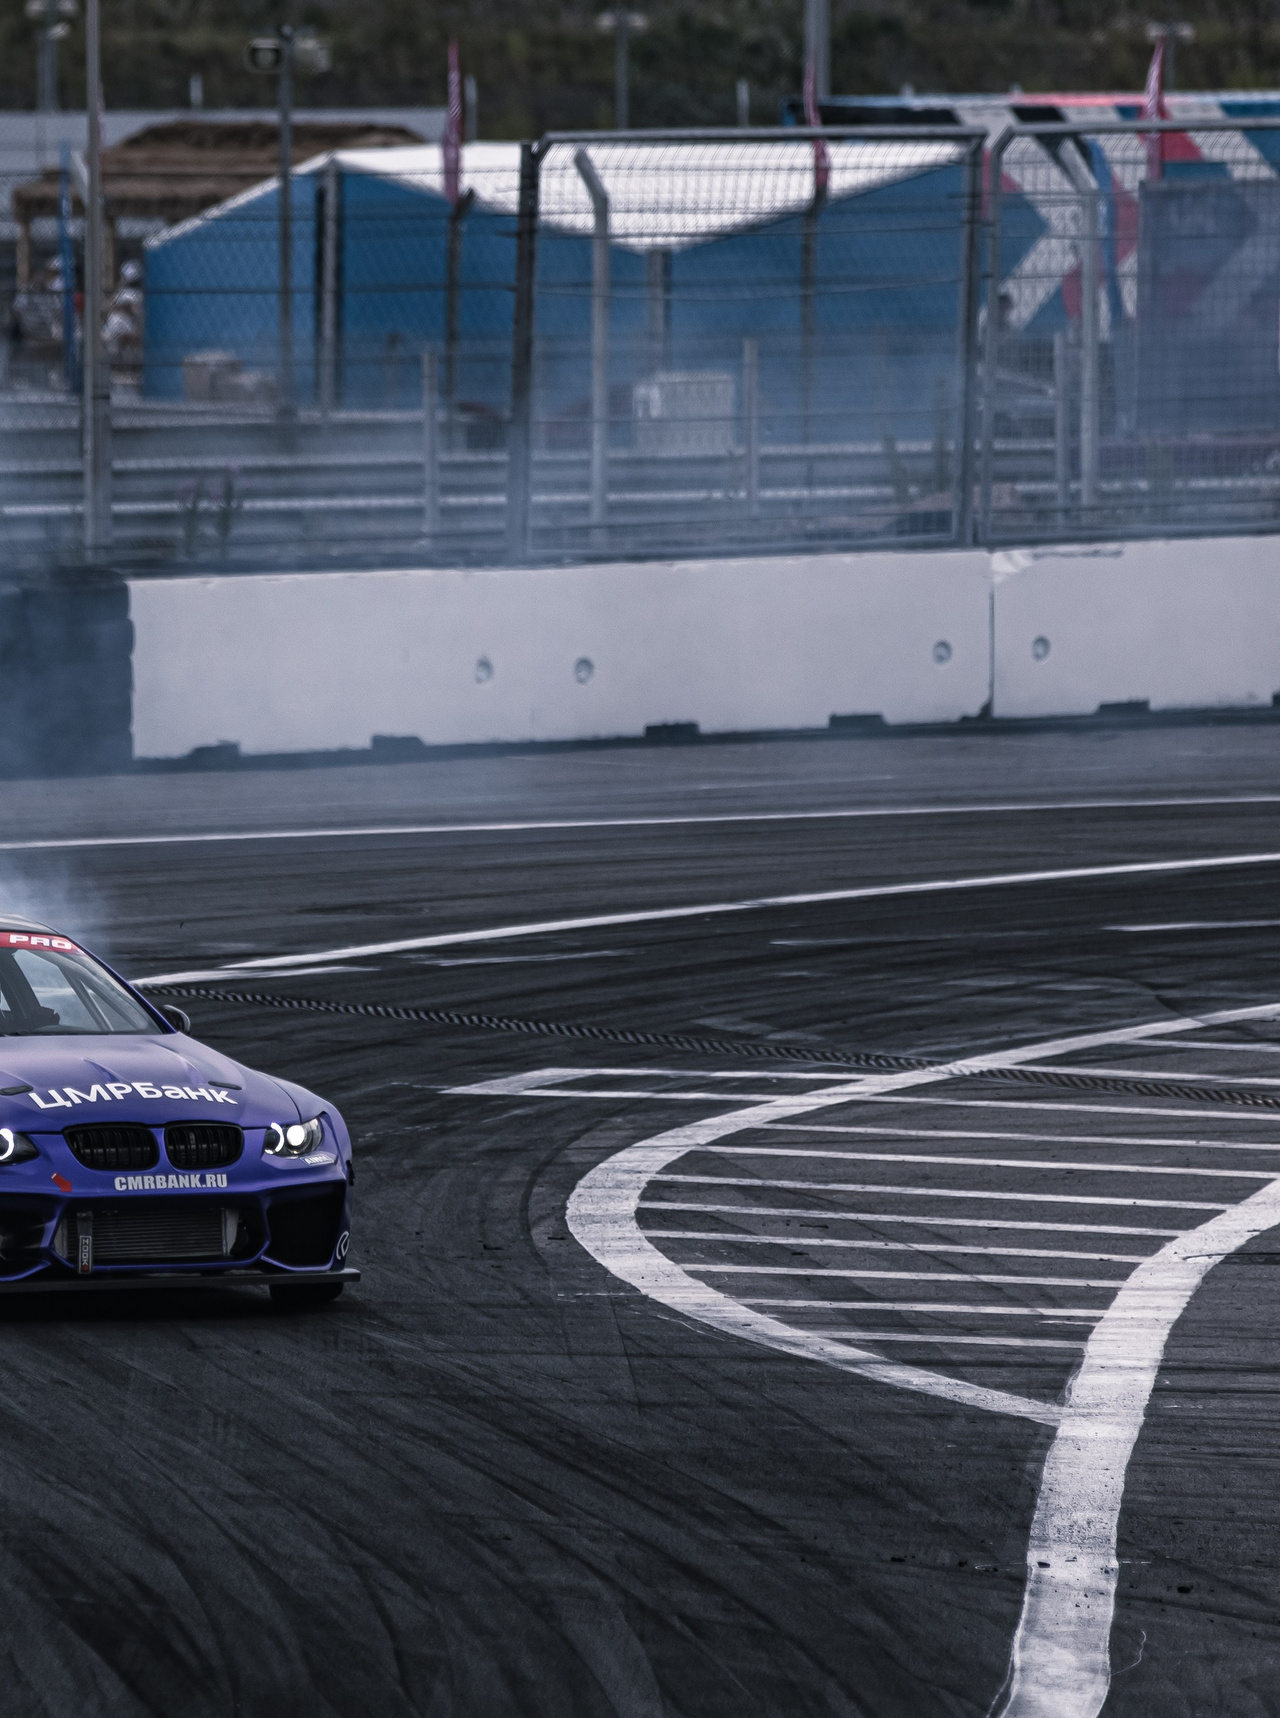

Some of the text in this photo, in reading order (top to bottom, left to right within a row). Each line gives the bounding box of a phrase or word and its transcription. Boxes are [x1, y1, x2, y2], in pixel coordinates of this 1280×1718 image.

[9, 934, 72, 950] PRO
[28, 1082, 239, 1109] ЦМРБанк
[114, 1174, 228, 1191] CMRBANK.RU
